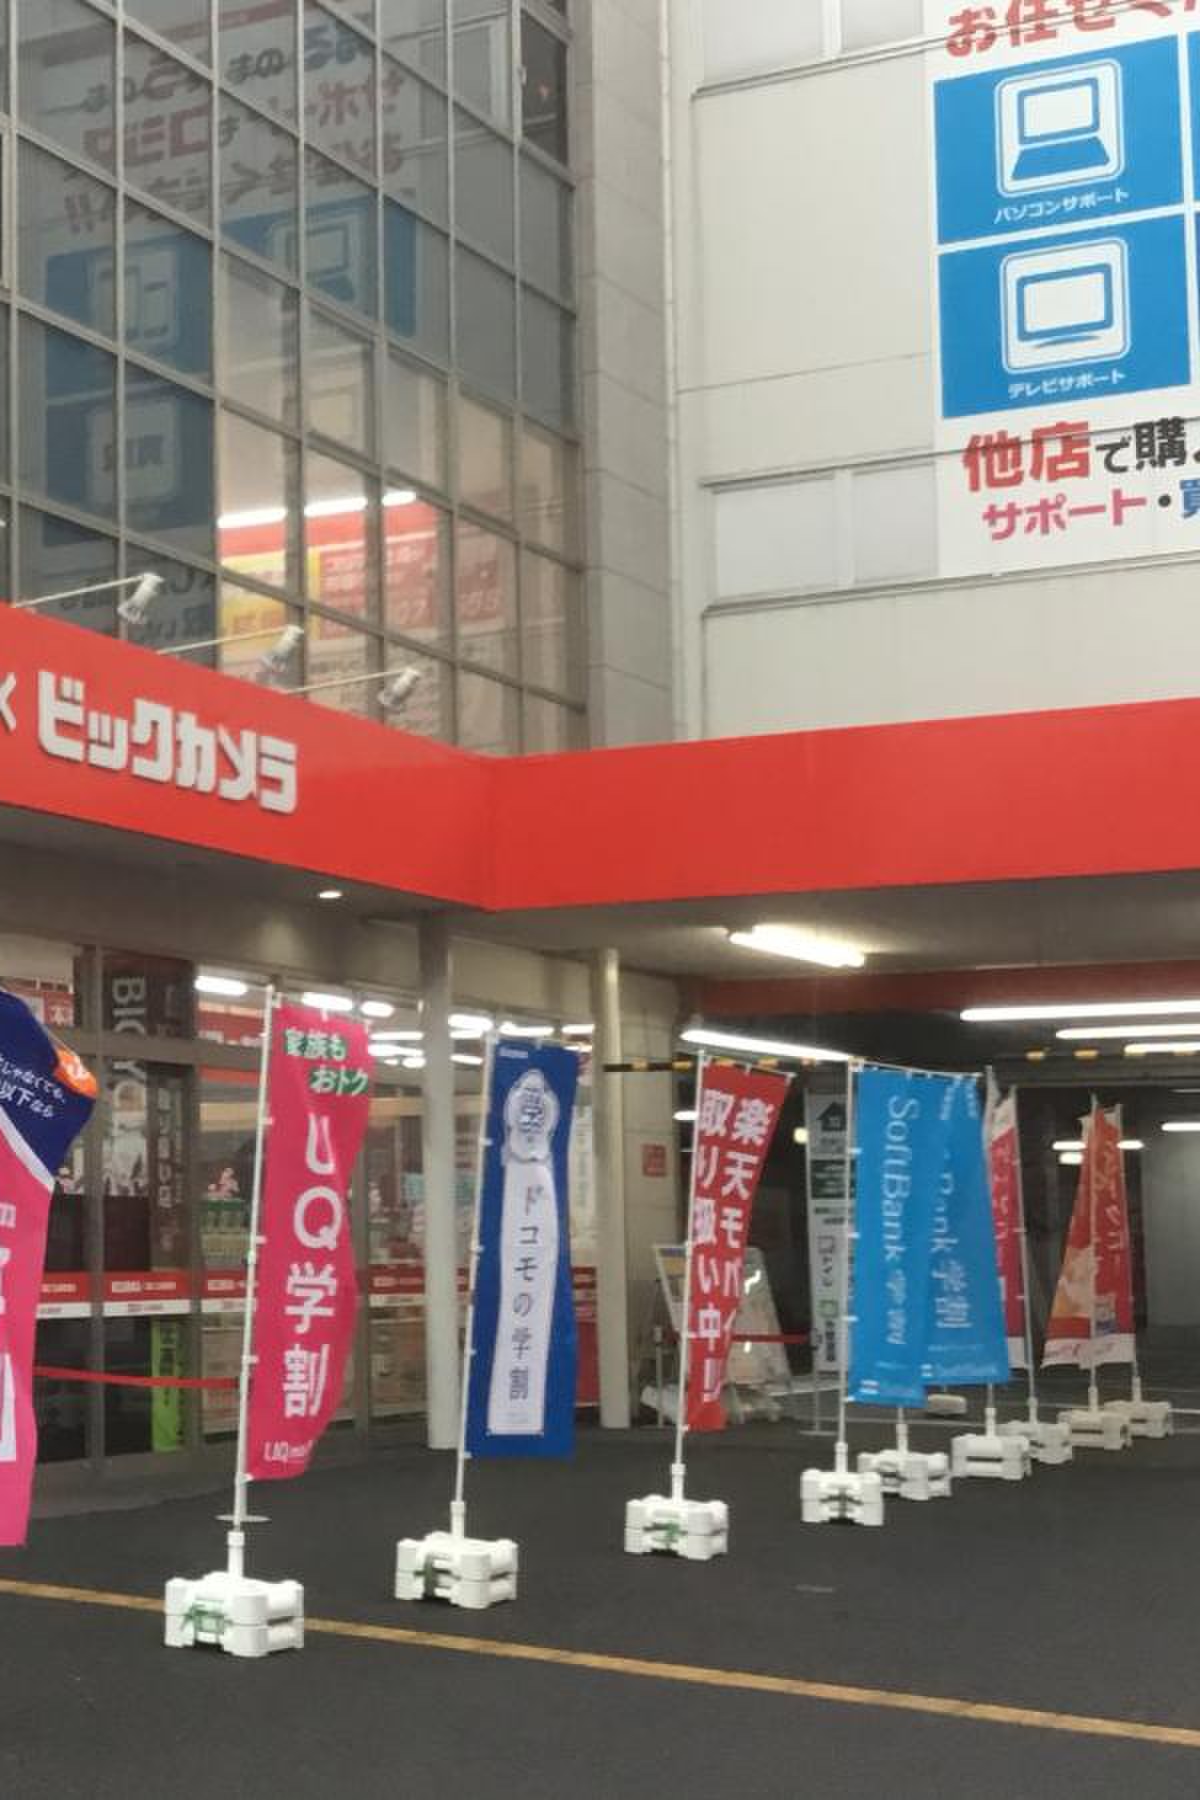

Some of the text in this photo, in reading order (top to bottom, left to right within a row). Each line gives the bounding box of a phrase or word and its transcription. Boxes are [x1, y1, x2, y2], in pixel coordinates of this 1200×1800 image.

[994, 188, 1128, 223] パソコンサポート
[1008, 369, 1125, 399] テレビサポート
[961, 416, 1200, 491] 他店で購
[37, 670, 296, 814] ビックカメラ
[310, 1066, 368, 1095] おトク
